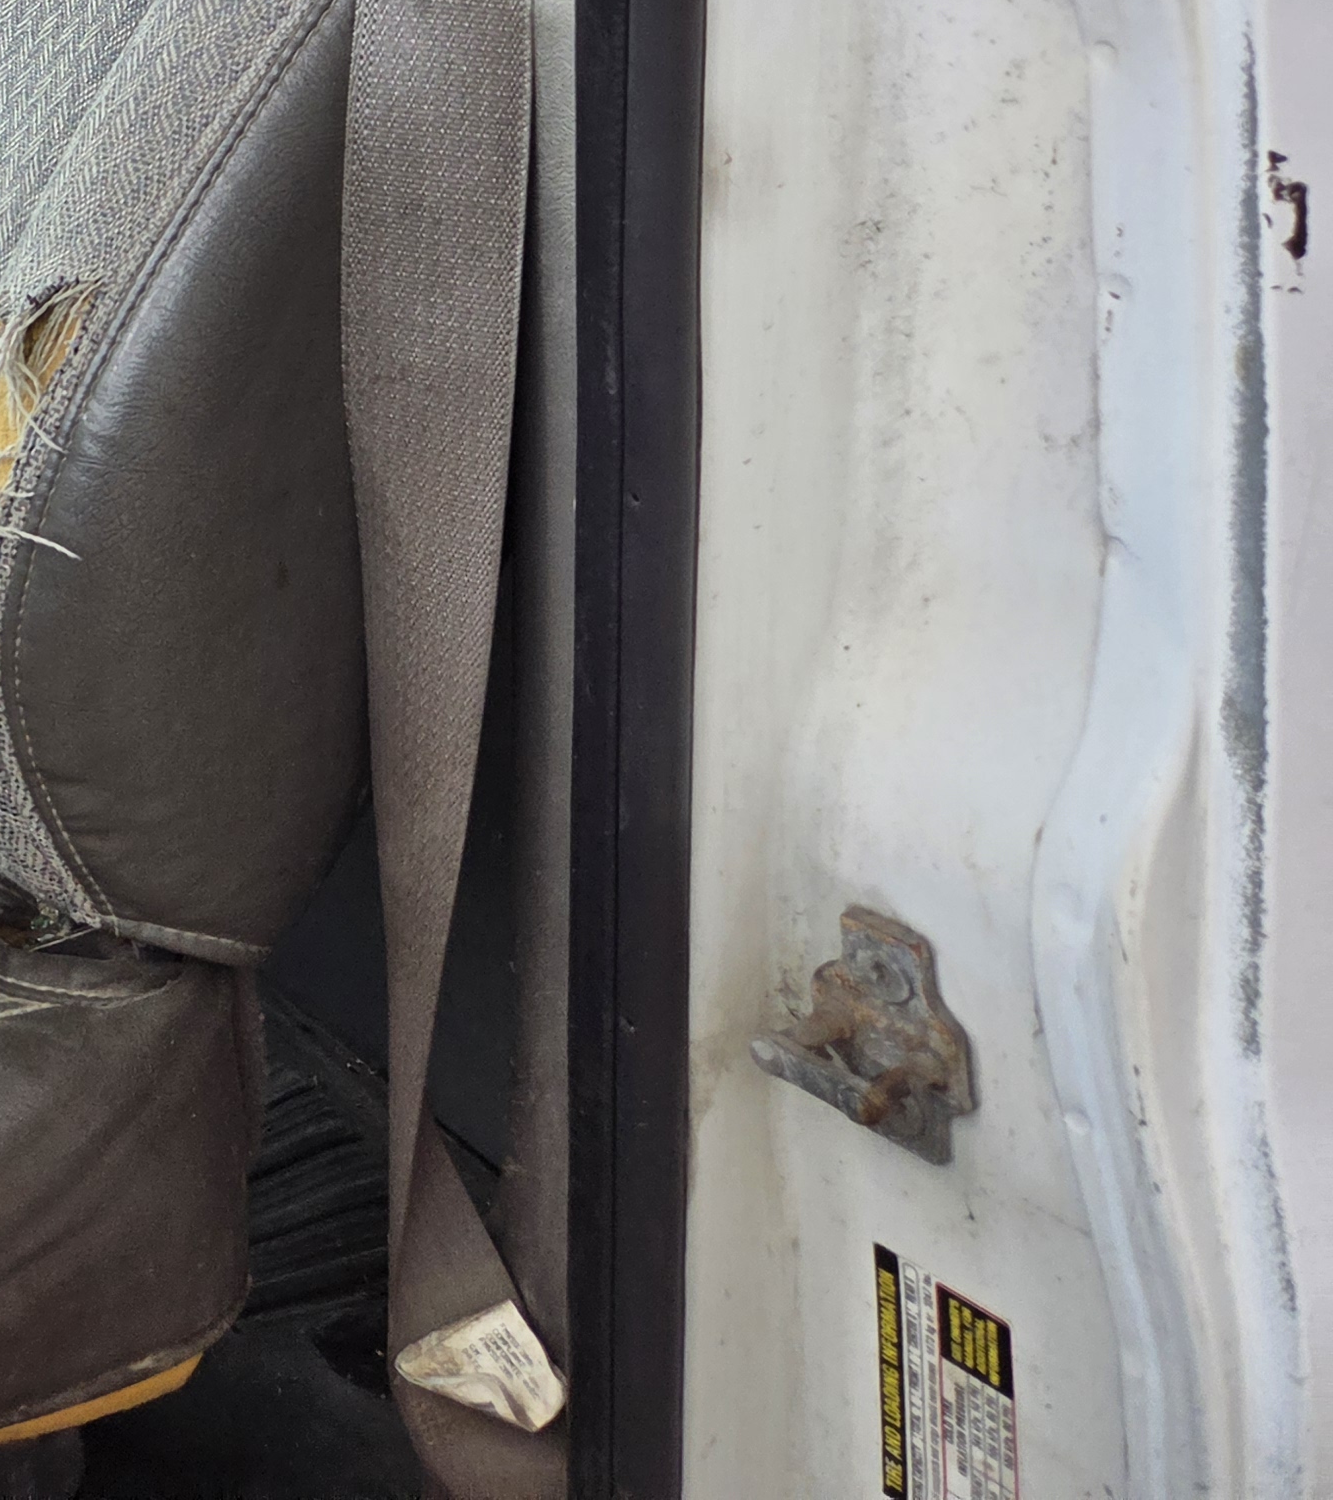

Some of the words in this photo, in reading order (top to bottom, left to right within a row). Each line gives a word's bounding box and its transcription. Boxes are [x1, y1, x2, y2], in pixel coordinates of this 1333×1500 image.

[878, 1268, 898, 1367] INFORMATION
[882, 1363, 902, 1428] LOADING
[884, 1425, 902, 1461] AND
[885, 1457, 903, 1493] TIRE
